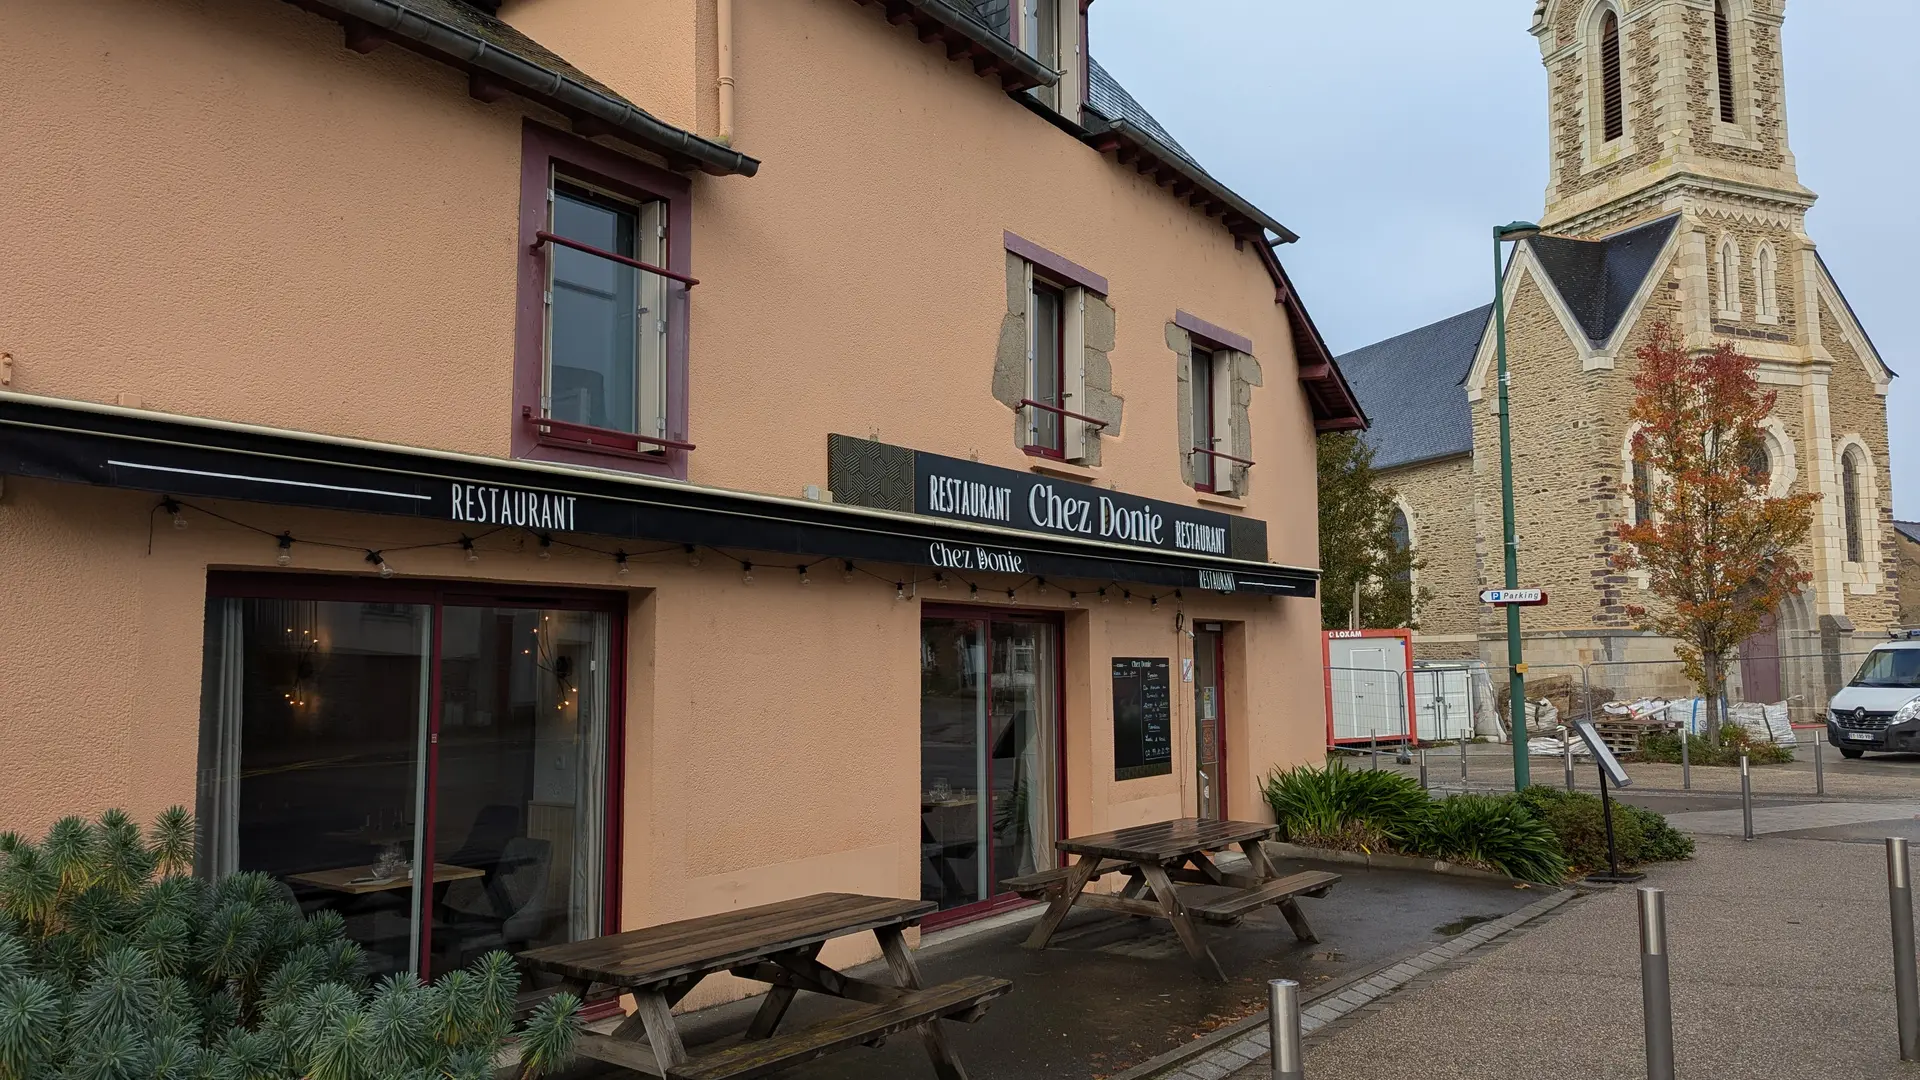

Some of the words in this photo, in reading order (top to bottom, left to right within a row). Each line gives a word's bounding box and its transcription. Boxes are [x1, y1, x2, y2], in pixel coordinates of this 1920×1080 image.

[452, 483, 577, 531] RESTAURANT
[929, 474, 1012, 522] RESTAURANT
[1029, 483, 1092, 534] Chez
[1099, 496, 1164, 545] Donie
[1175, 520, 1226, 554] RESTAURANT
[929, 541, 974, 569] Chez
[976, 546, 1025, 573] Donie
[1198, 569, 1236, 591] RESTAURANT
[1503, 591, 1539, 600] Parking
[1335, 630, 1362, 638] LOXAM
